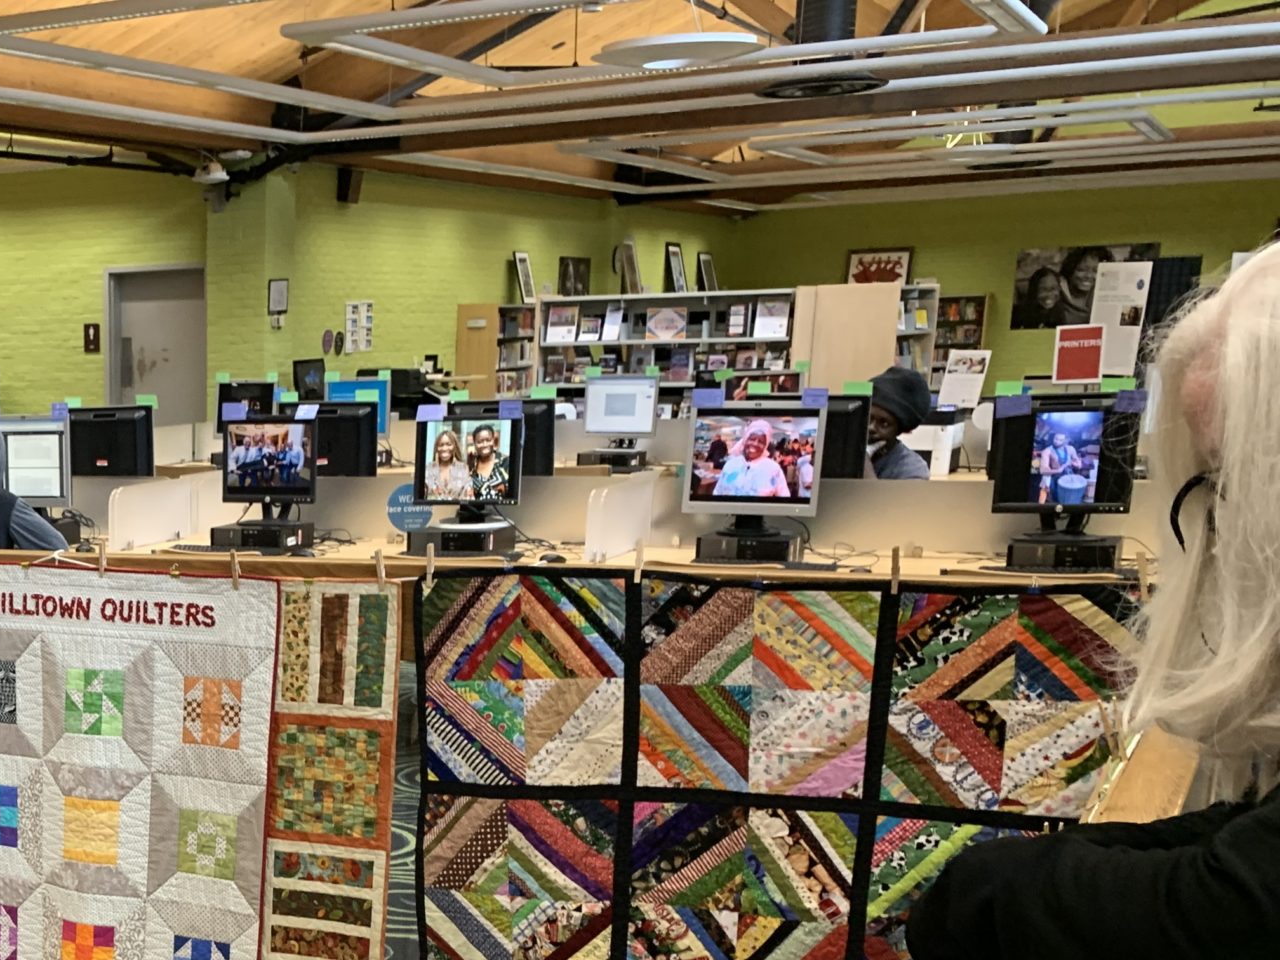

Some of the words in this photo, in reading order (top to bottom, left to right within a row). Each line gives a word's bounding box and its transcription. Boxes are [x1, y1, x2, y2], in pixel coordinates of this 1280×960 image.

[1058, 339, 1102, 348] PRINTERS
[398, 494, 414, 503] WE
[100, 597, 216, 628] QUILTERS
